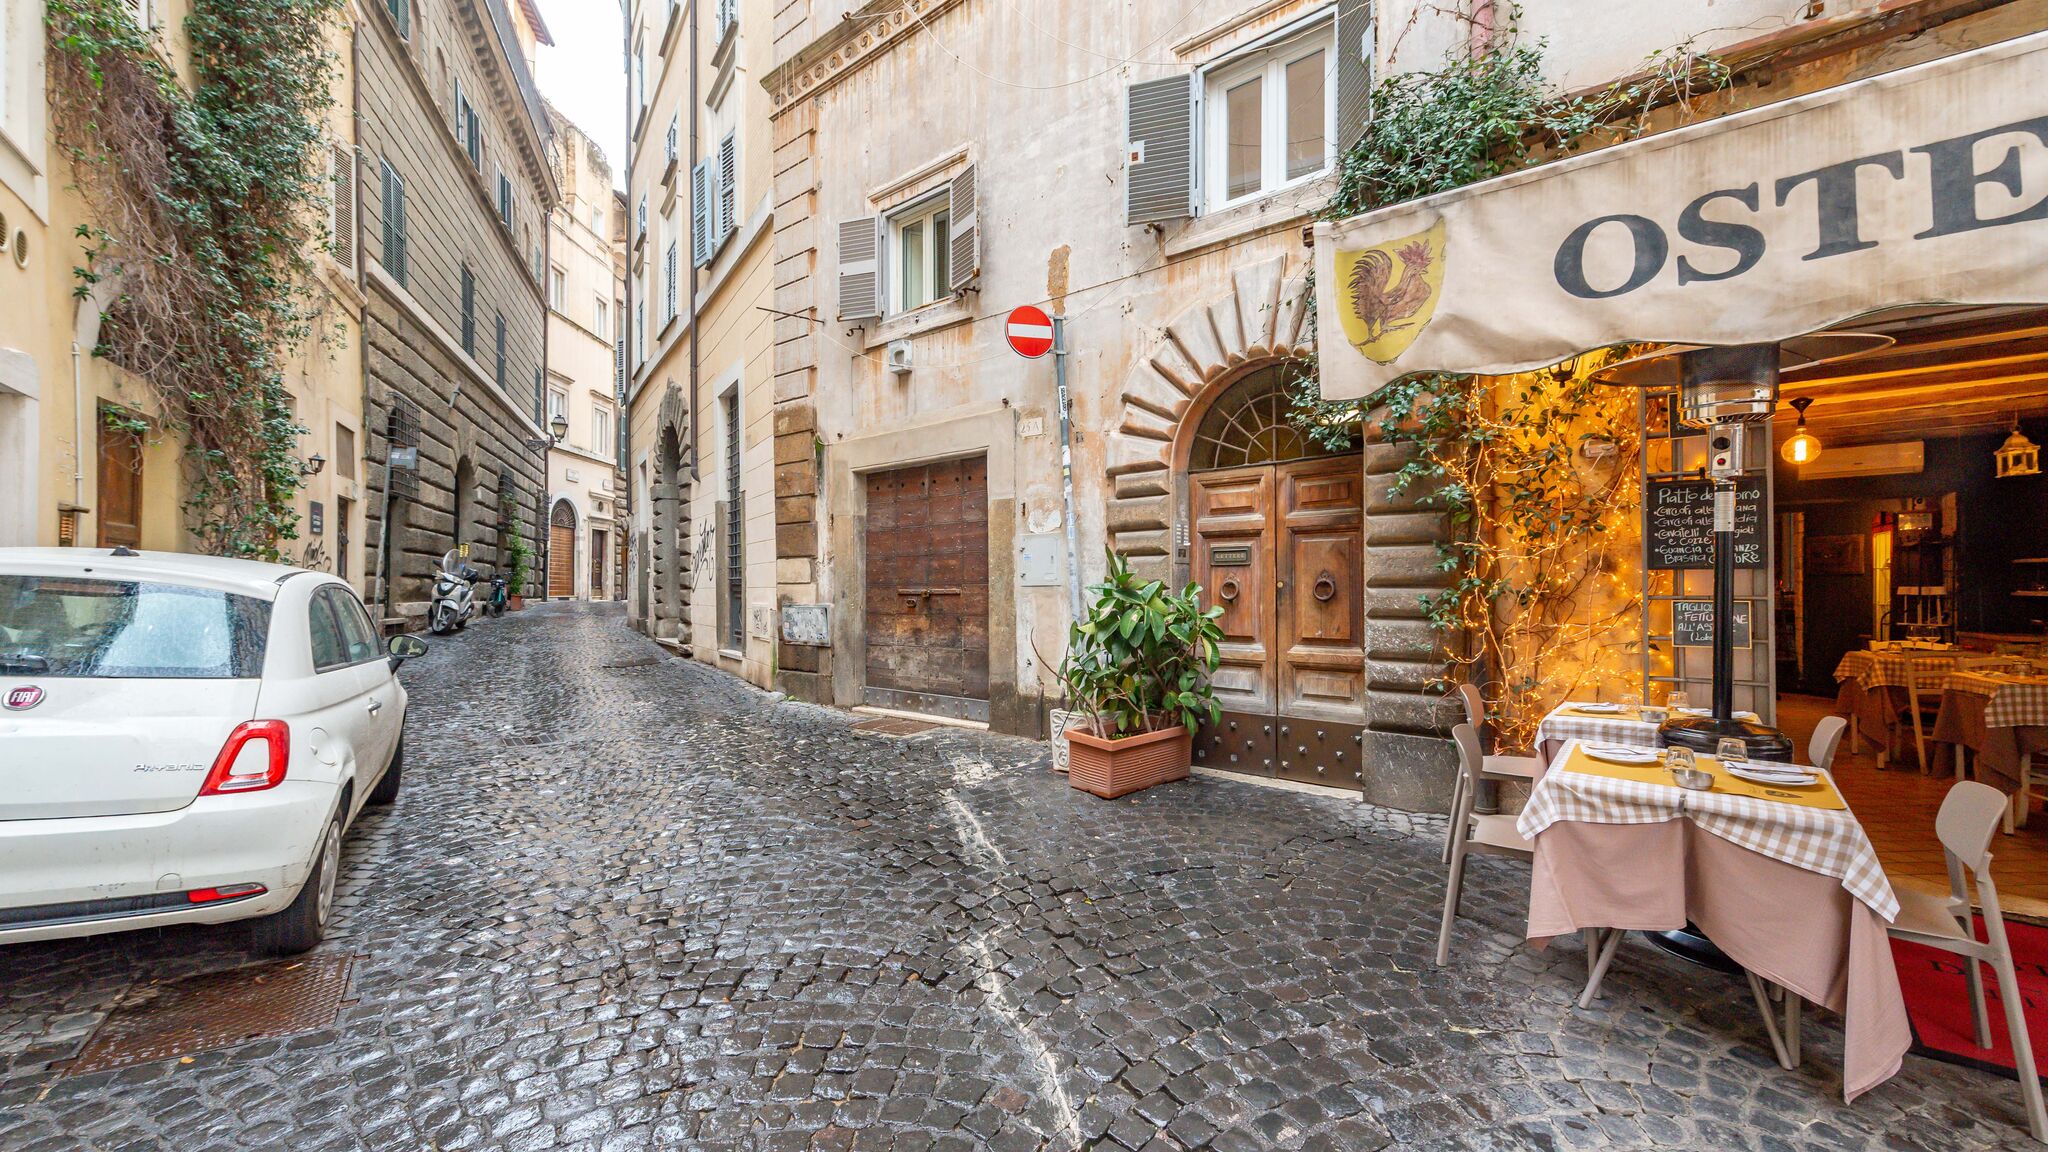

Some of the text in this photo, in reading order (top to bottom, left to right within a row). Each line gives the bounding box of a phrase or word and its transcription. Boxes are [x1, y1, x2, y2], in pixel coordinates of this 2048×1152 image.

[1553, 115, 2048, 299] OSTE
[1659, 487, 1699, 505] Piatto
[10, 691, 39, 702] FIAT
